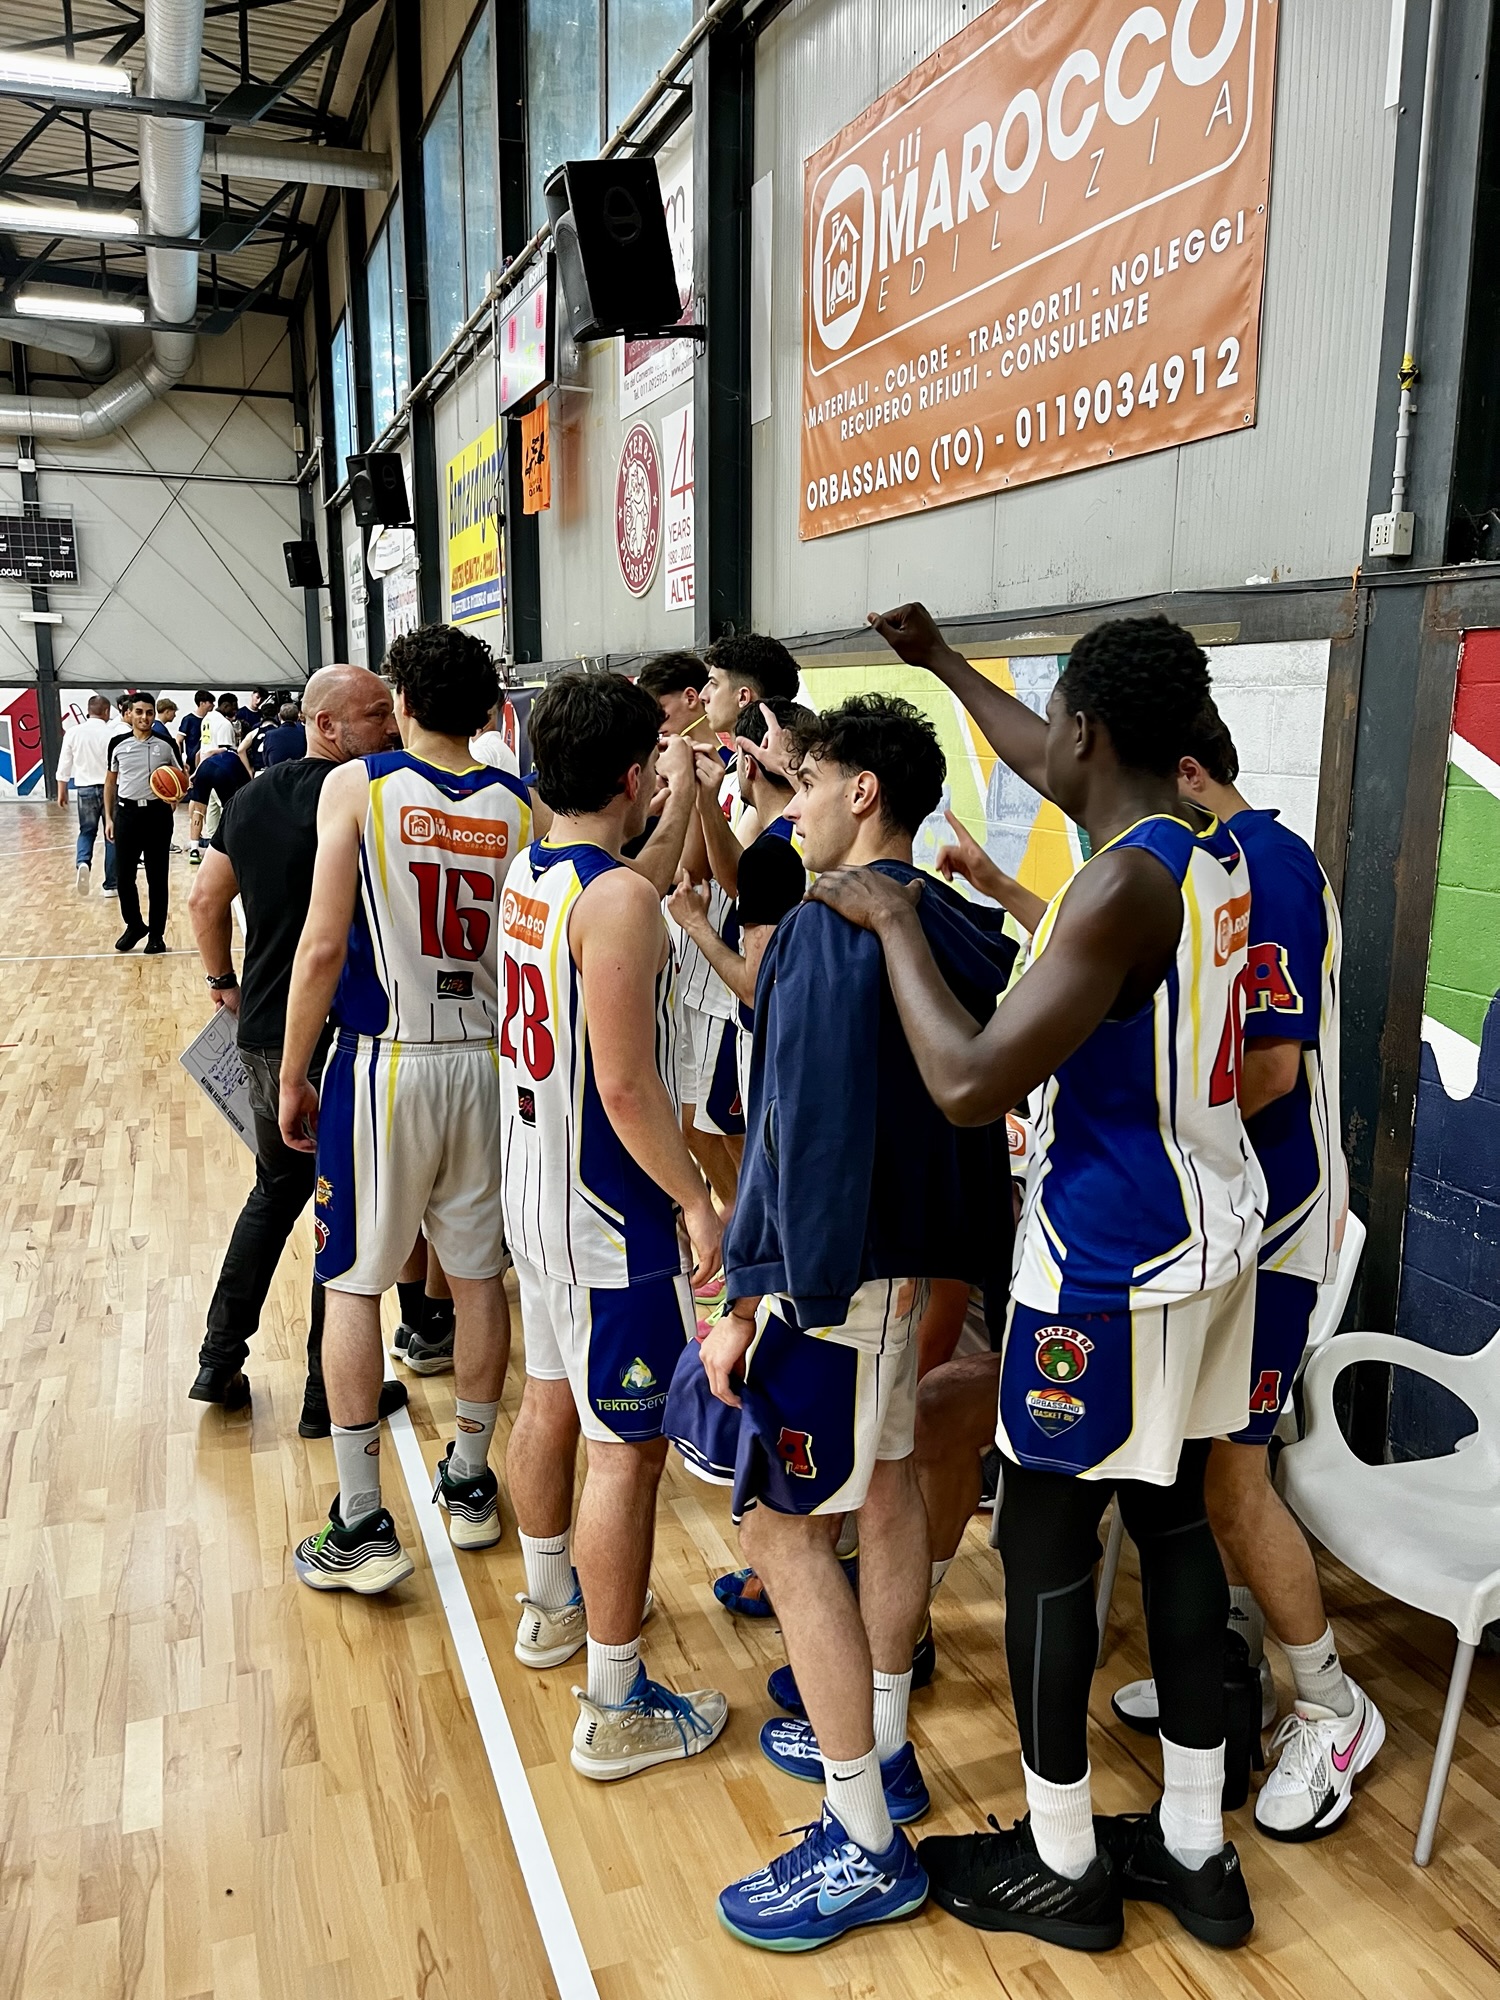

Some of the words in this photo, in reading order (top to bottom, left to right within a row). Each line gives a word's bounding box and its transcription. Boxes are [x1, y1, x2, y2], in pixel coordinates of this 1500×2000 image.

[879, 0, 1245, 272] MAROCCO
[881, 127, 921, 185] f.lli
[808, 380, 869, 429] MATERIALI
[885, 344, 948, 389] COLORE
[969, 286, 1081, 355] TRASPORTI
[1111, 210, 1244, 297] NOLEGGI
[841, 391, 911, 441] RECUPERO
[919, 369, 978, 410] RIFIUTI
[1000, 293, 1149, 378] CONSULENZE
[806, 448, 920, 512] ORBASSANO
[931, 424, 985, 484] (TO)
[1016, 336, 1239, 448] 0119034912
[668, 516, 691, 543] YEARS
[49, 570, 74, 578] OSPITI
[435, 824, 507, 847] MAROCCO
[408, 862, 494, 962] 16
[500, 950, 554, 1081] 28
[1037, 1327, 1079, 1341] ALTER
[1030, 1397, 1080, 1413] ORBASSANO
